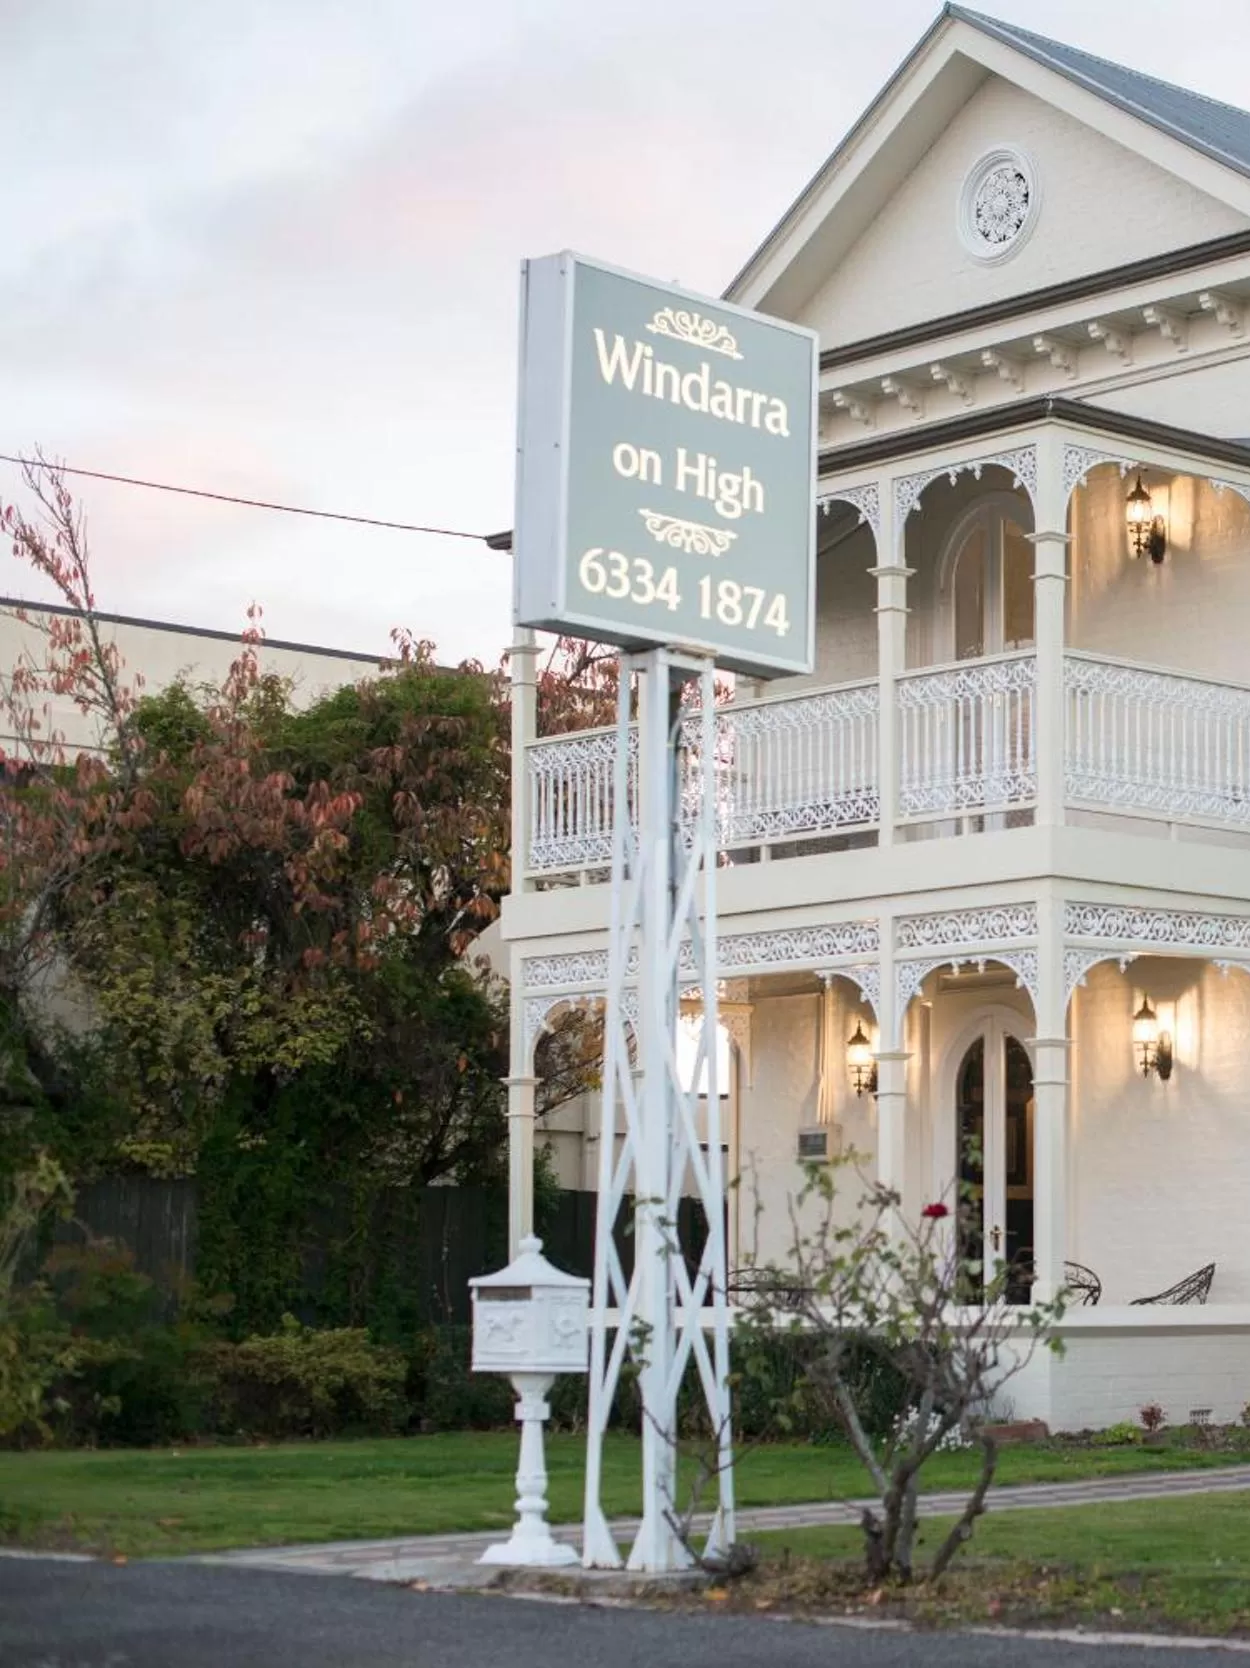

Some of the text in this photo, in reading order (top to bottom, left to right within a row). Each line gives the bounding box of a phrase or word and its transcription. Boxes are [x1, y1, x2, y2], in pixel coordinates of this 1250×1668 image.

[594, 328, 790, 437] Windarra
[613, 442, 765, 519] on High
[579, 548, 790, 636] 6334 1874
